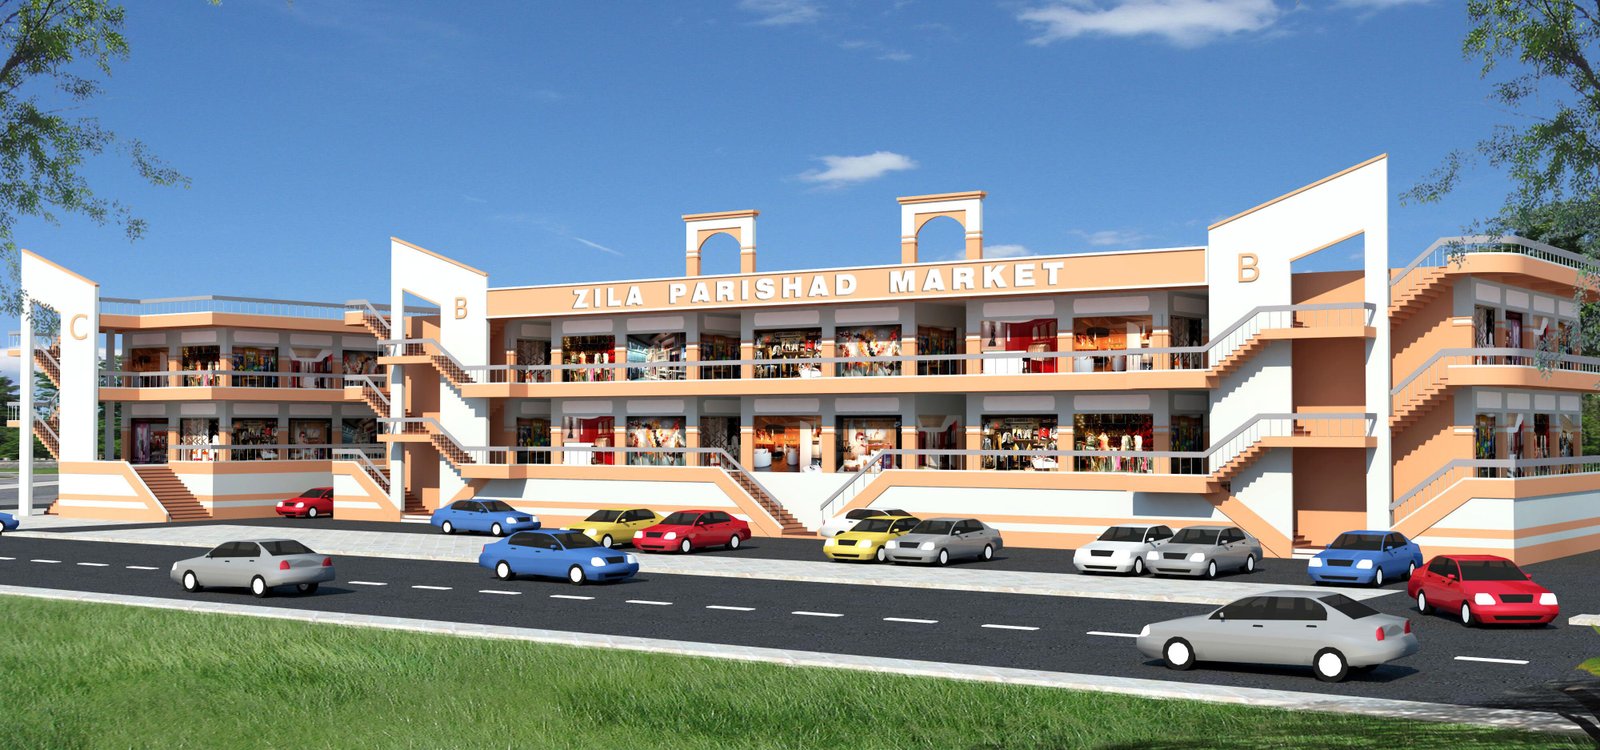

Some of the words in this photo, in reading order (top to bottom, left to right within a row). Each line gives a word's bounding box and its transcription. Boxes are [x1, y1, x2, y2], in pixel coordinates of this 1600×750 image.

[1238, 253, 1260, 283] B
[572, 285, 644, 309] ZILA
[668, 273, 857, 304] PARISHAD
[889, 261, 1065, 293] MARKET
[455, 296, 468, 320] B
[70, 313, 88, 340] C
